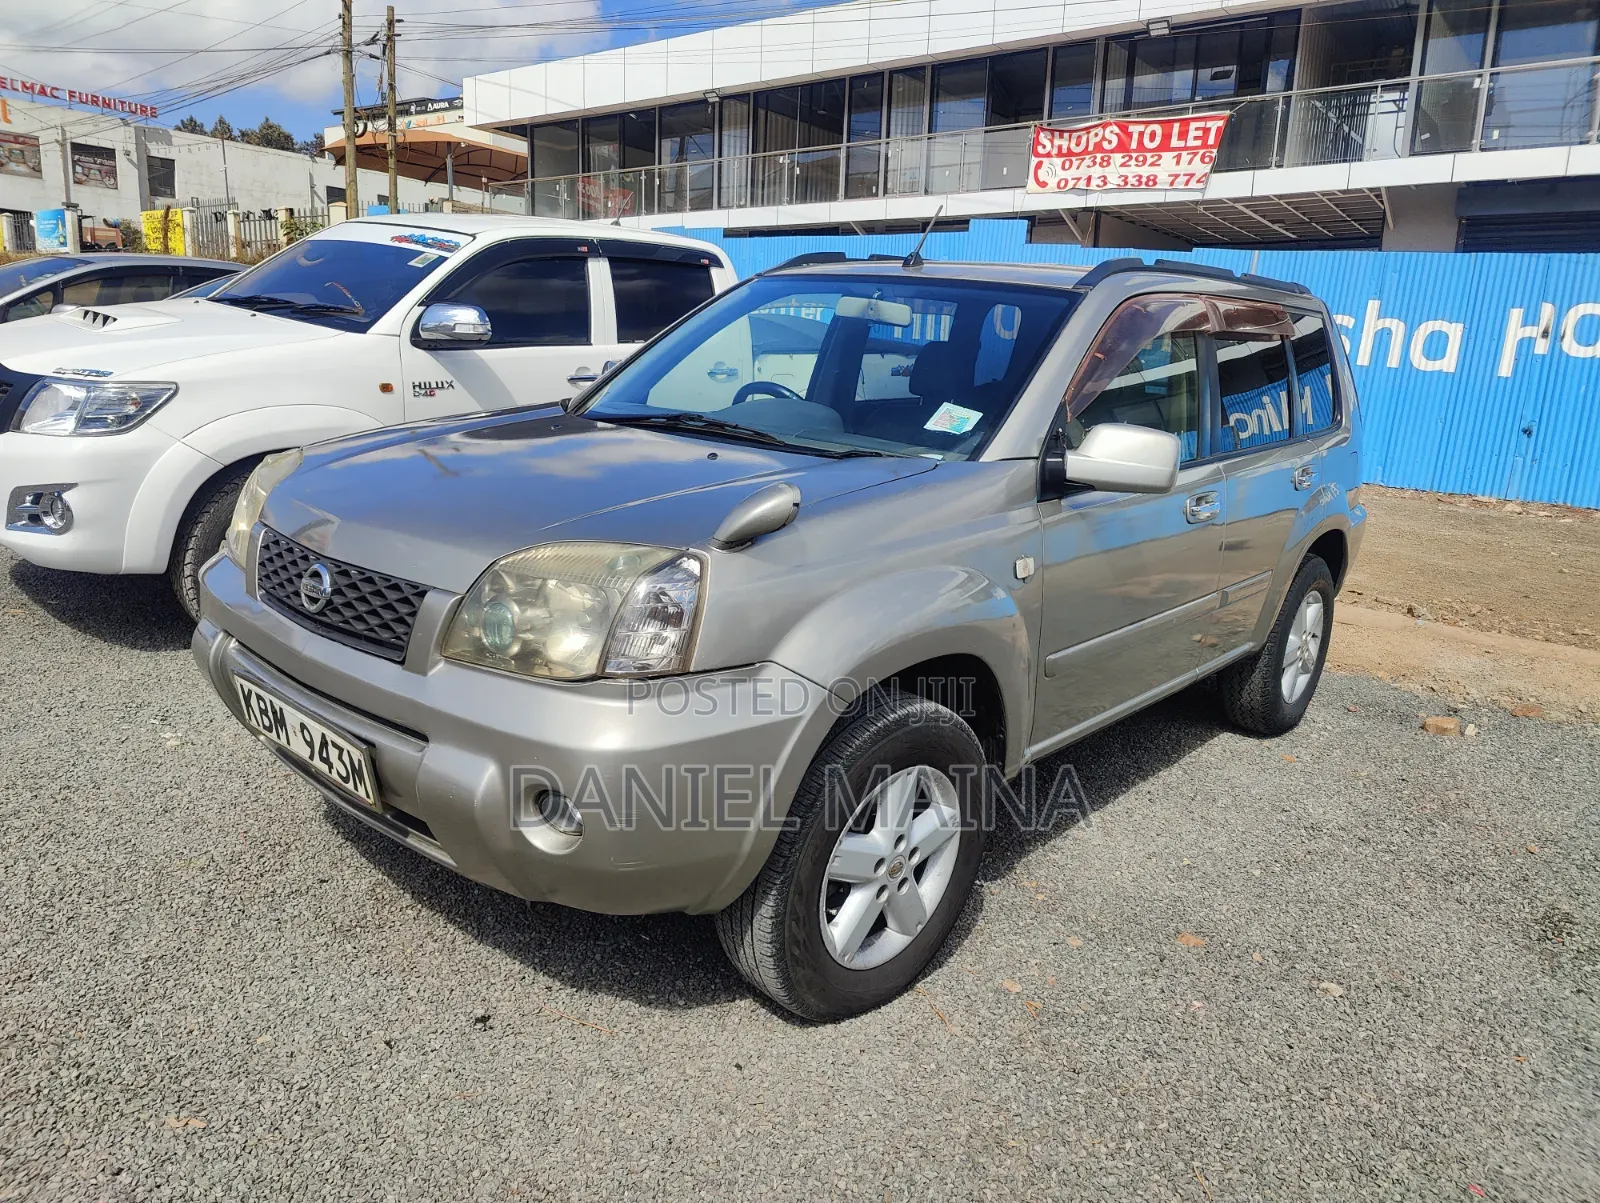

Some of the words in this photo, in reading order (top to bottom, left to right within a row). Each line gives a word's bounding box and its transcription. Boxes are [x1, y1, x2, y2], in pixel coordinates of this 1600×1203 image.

[67, 89, 158, 118] FURNITURE
[1037, 127, 1119, 155] SHOPS
[1128, 124, 1162, 150] TO
[1170, 120, 1224, 148] LET
[1061, 155, 1111, 171] 0738
[1119, 153, 1163, 168] 292
[1172, 151, 1214, 166] 176
[1056, 175, 1108, 190] 0713
[1117, 174, 1158, 188] 338
[1168, 172, 1208, 187] 774
[412, 380, 455, 390] HILUX
[240, 684, 290, 746] KBM
[300, 722, 371, 799] 943M
